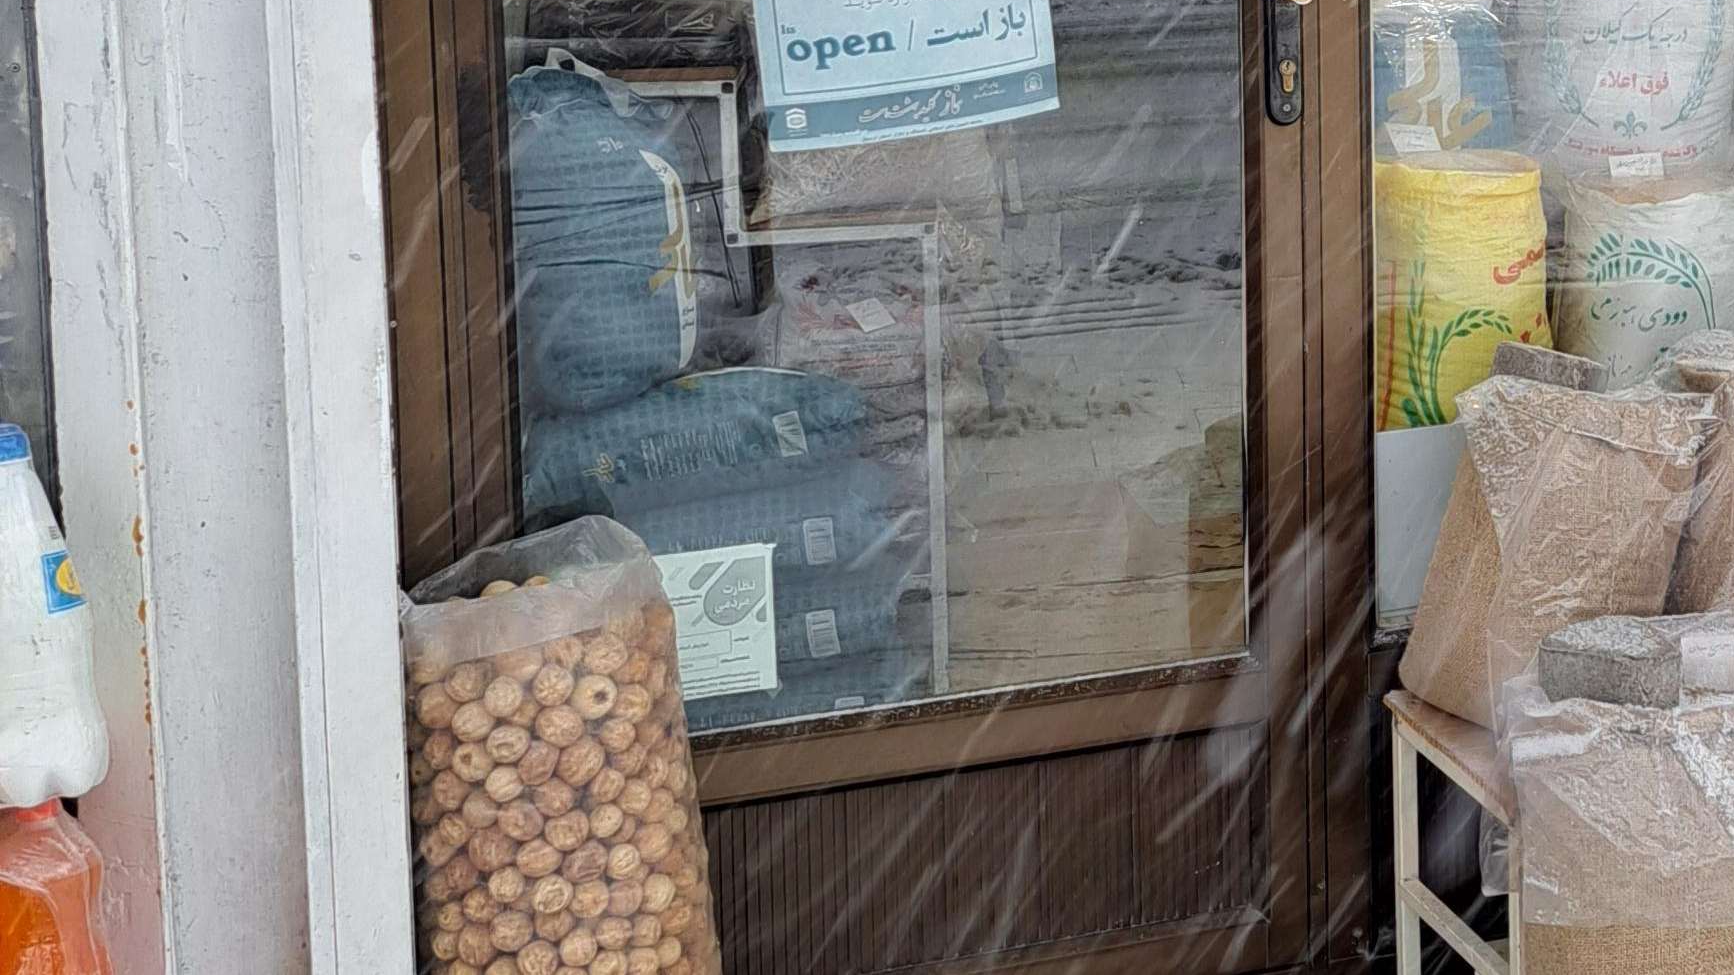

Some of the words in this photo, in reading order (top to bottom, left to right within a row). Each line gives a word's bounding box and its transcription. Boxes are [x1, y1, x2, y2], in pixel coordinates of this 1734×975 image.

[927, 9, 990, 47] است
[994, 3, 1027, 41] باز
[786, 29, 896, 71] open
[1640, 71, 1670, 95] فوق
[722, 579, 757, 596] نظارت
